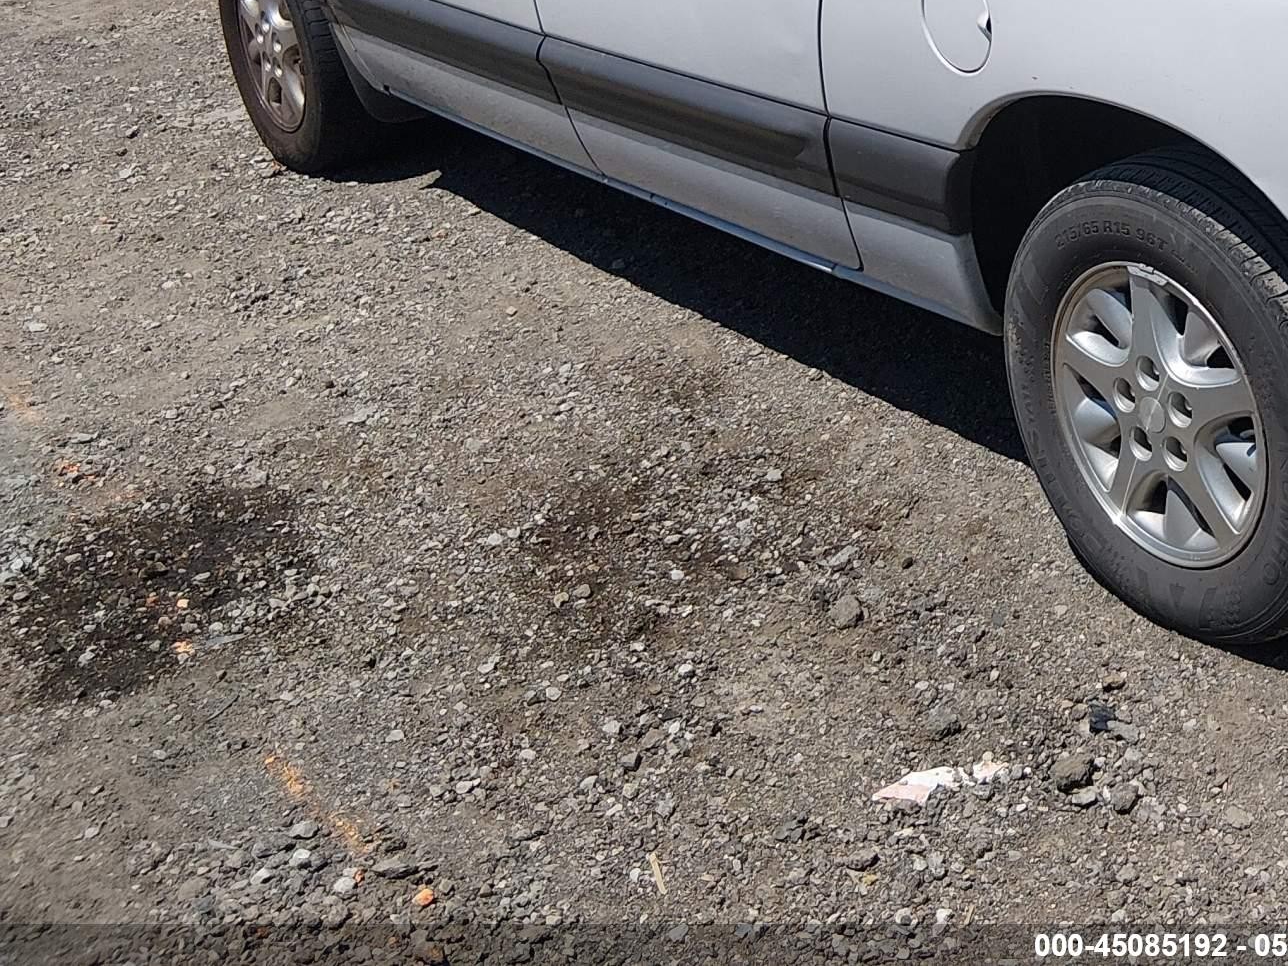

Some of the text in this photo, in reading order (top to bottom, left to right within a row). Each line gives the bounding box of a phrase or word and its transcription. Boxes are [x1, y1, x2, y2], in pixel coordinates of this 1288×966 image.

[1054, 220, 1168, 250] 215/65 R15 96T
